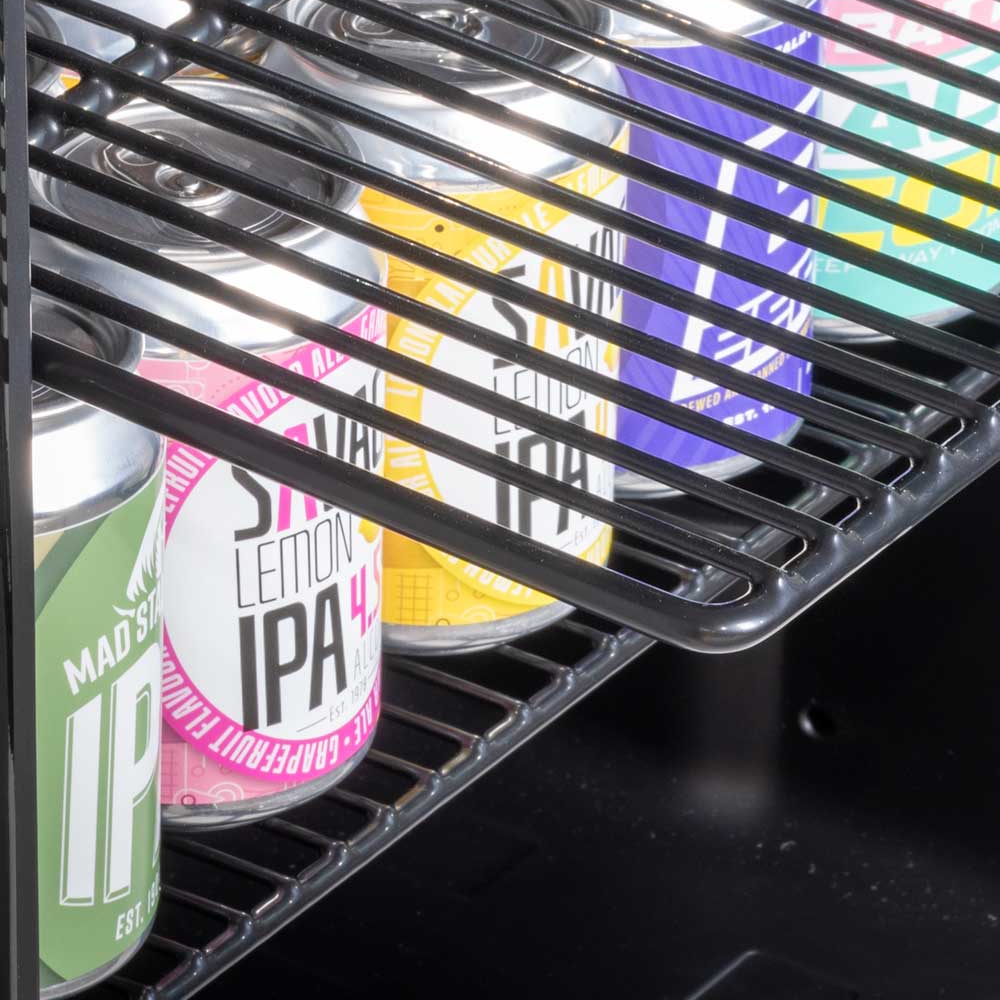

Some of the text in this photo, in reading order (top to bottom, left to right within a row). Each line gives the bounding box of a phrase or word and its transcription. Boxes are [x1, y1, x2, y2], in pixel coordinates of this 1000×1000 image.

[495, 409, 590, 538] IPA
[235, 511, 352, 609] LEMON
[62, 619, 131, 697] MAD
[238, 582, 348, 733] IPA
[59, 641, 160, 906] IP
[208, 725, 340, 775] GRAPEFRUIT
[115, 900, 144, 941] EST.
